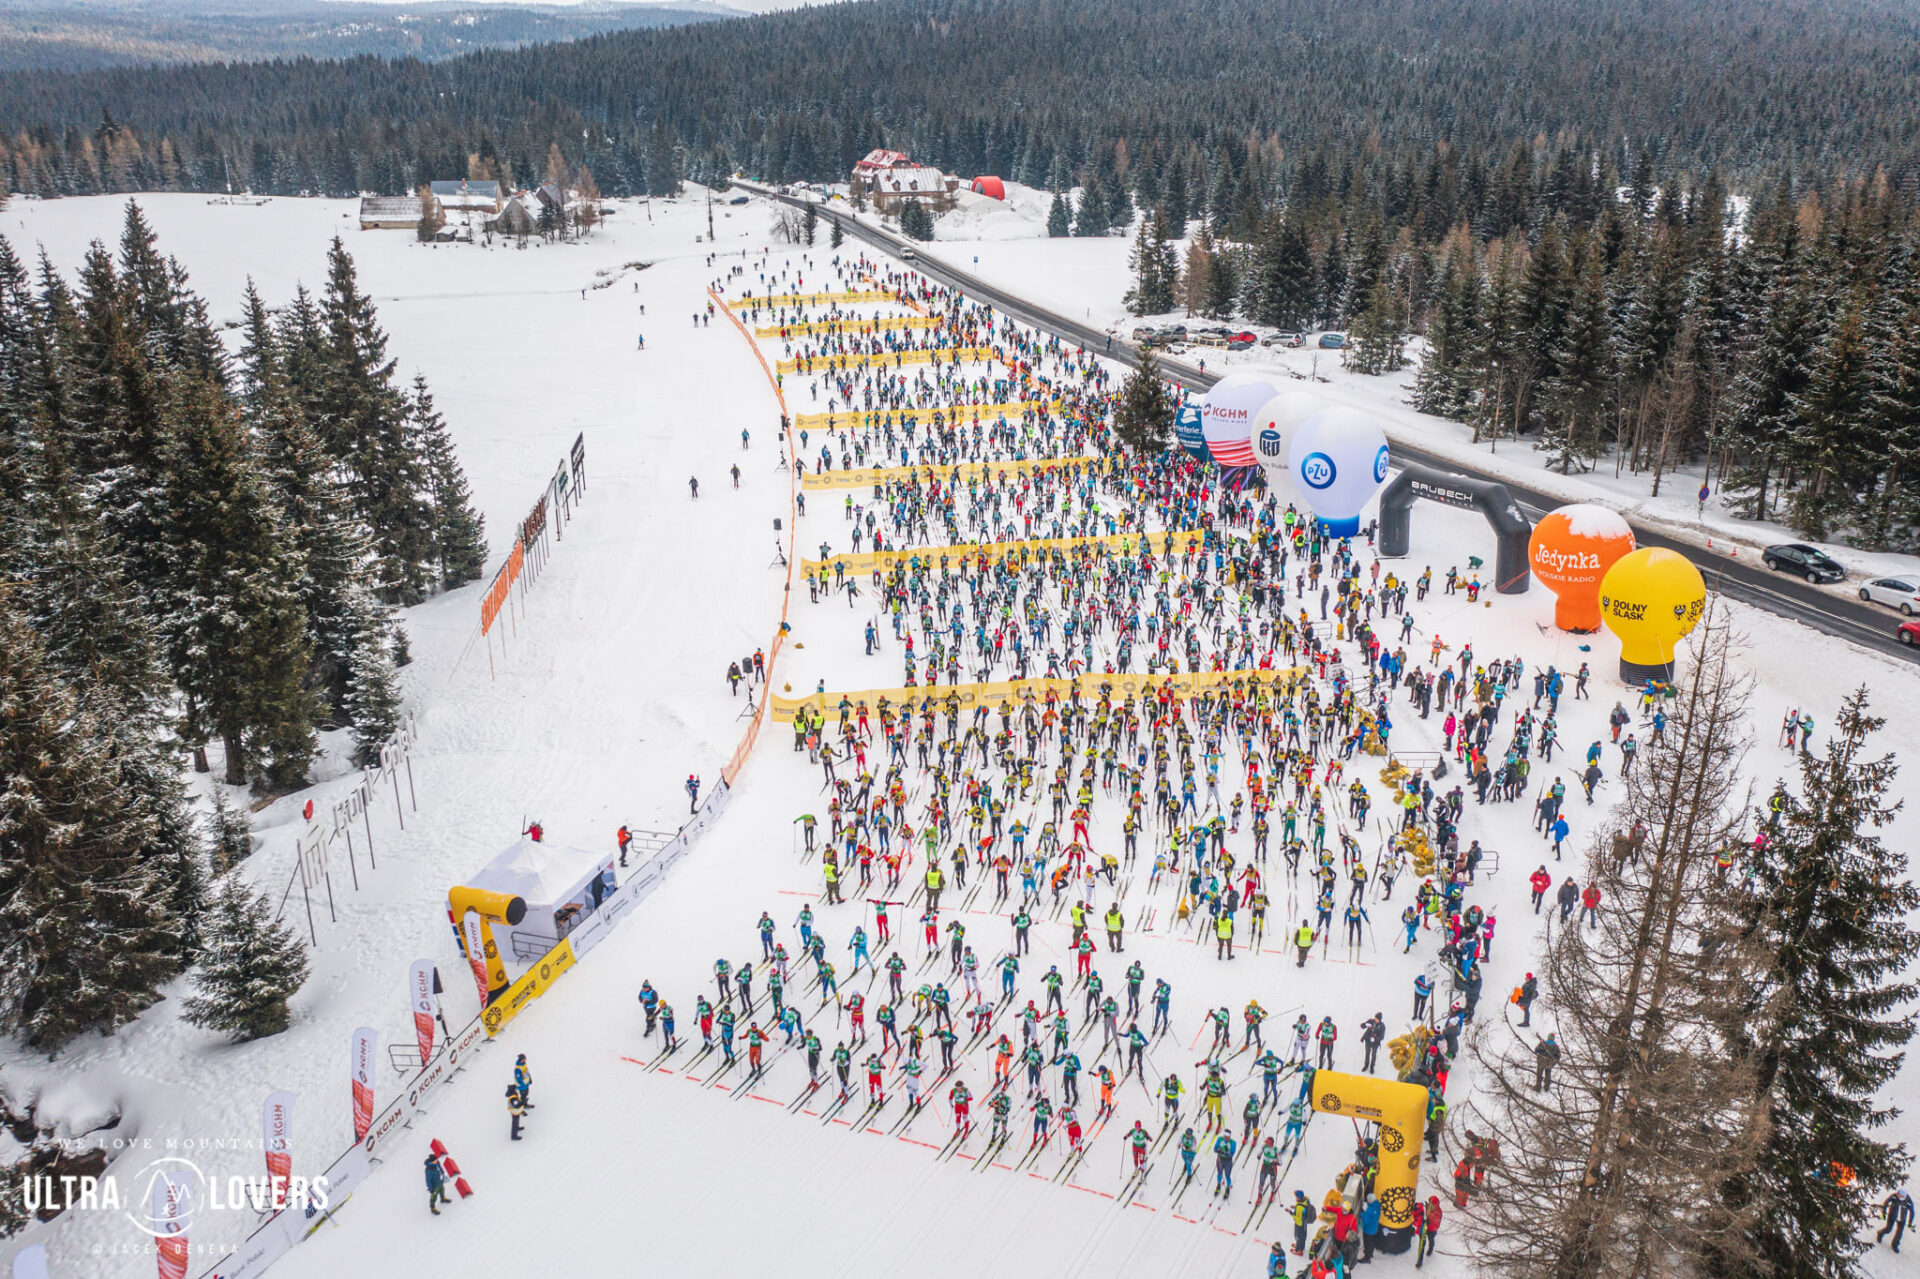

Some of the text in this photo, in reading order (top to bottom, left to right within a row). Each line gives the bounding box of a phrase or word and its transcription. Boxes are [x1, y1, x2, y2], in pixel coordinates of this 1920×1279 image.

[1212, 407, 1248, 419] KGHM
[1308, 463, 1328, 480] PZU
[1411, 480, 1474, 503] BRUBECK
[1535, 543, 1601, 572] Jedynka
[1538, 569, 1596, 583] POLSKIE RADIO
[1613, 599, 1648, 613] DOLNY
[458, 1026, 480, 1052] KGHM
[418, 1065, 442, 1093] KGHM
[274, 1104, 284, 1137] KGHM
[376, 1107, 402, 1138] KGHM
